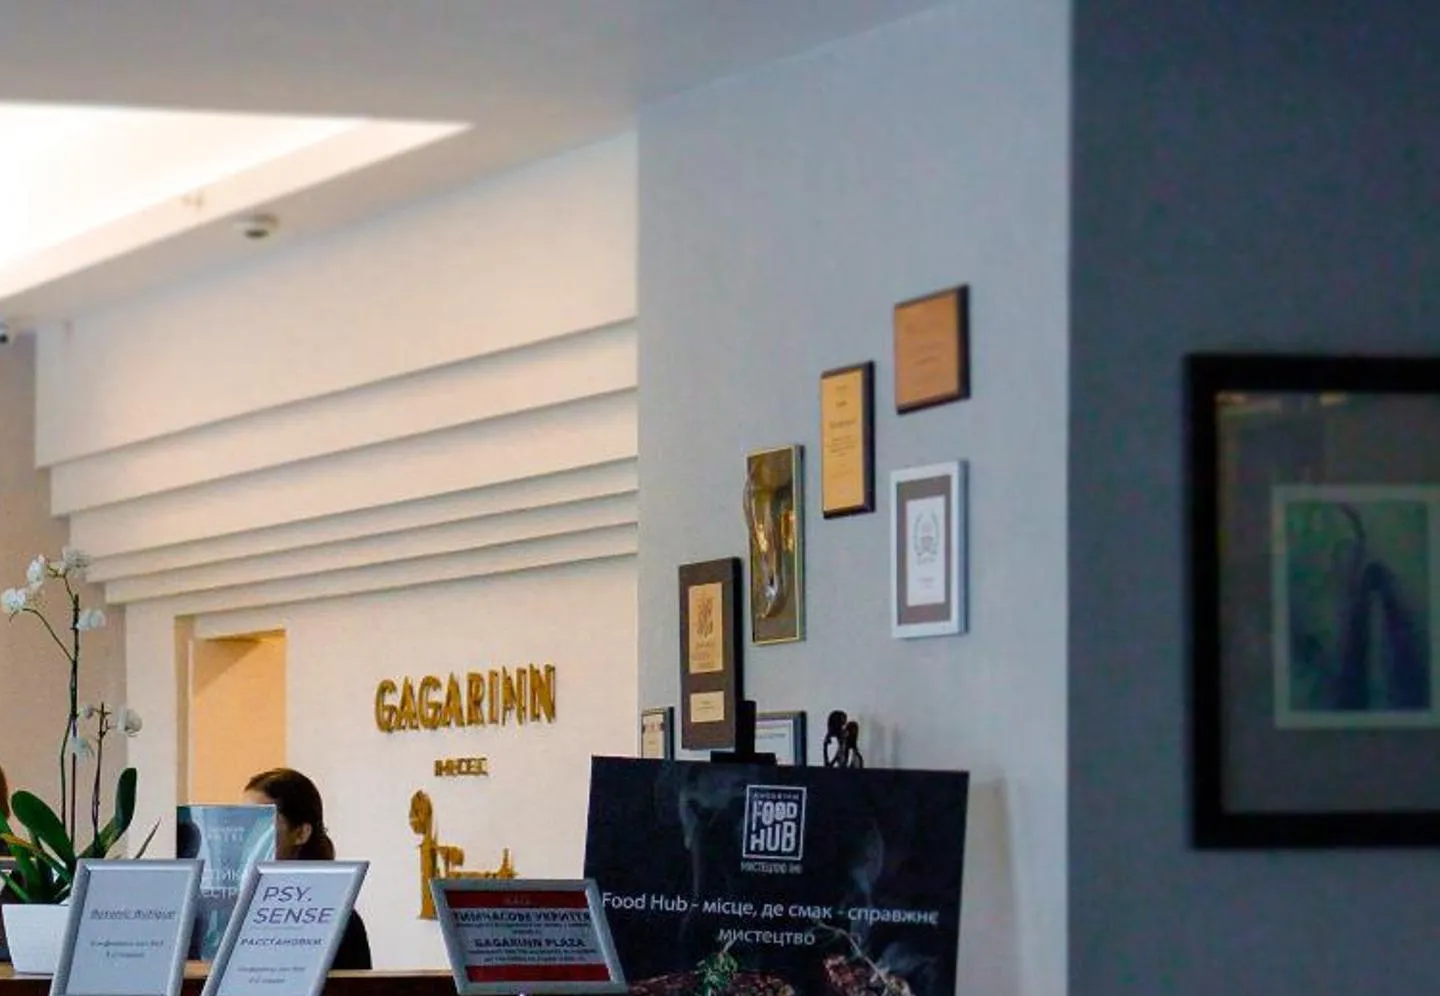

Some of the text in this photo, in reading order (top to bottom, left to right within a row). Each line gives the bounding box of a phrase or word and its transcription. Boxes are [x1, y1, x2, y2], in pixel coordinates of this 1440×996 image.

[374, 663, 556, 733] GAGARINN
[752, 800, 798, 832] FOOD
[750, 821, 796, 852] HUB
[253, 907, 335, 924] SENSE
[602, 892, 646, 910] Food
[650, 894, 688, 912] Hub
[702, 897, 758, 918] місце,
[761, 902, 784, 919] де
[788, 903, 833, 919] смак
[717, 928, 816, 947] мистецтво
